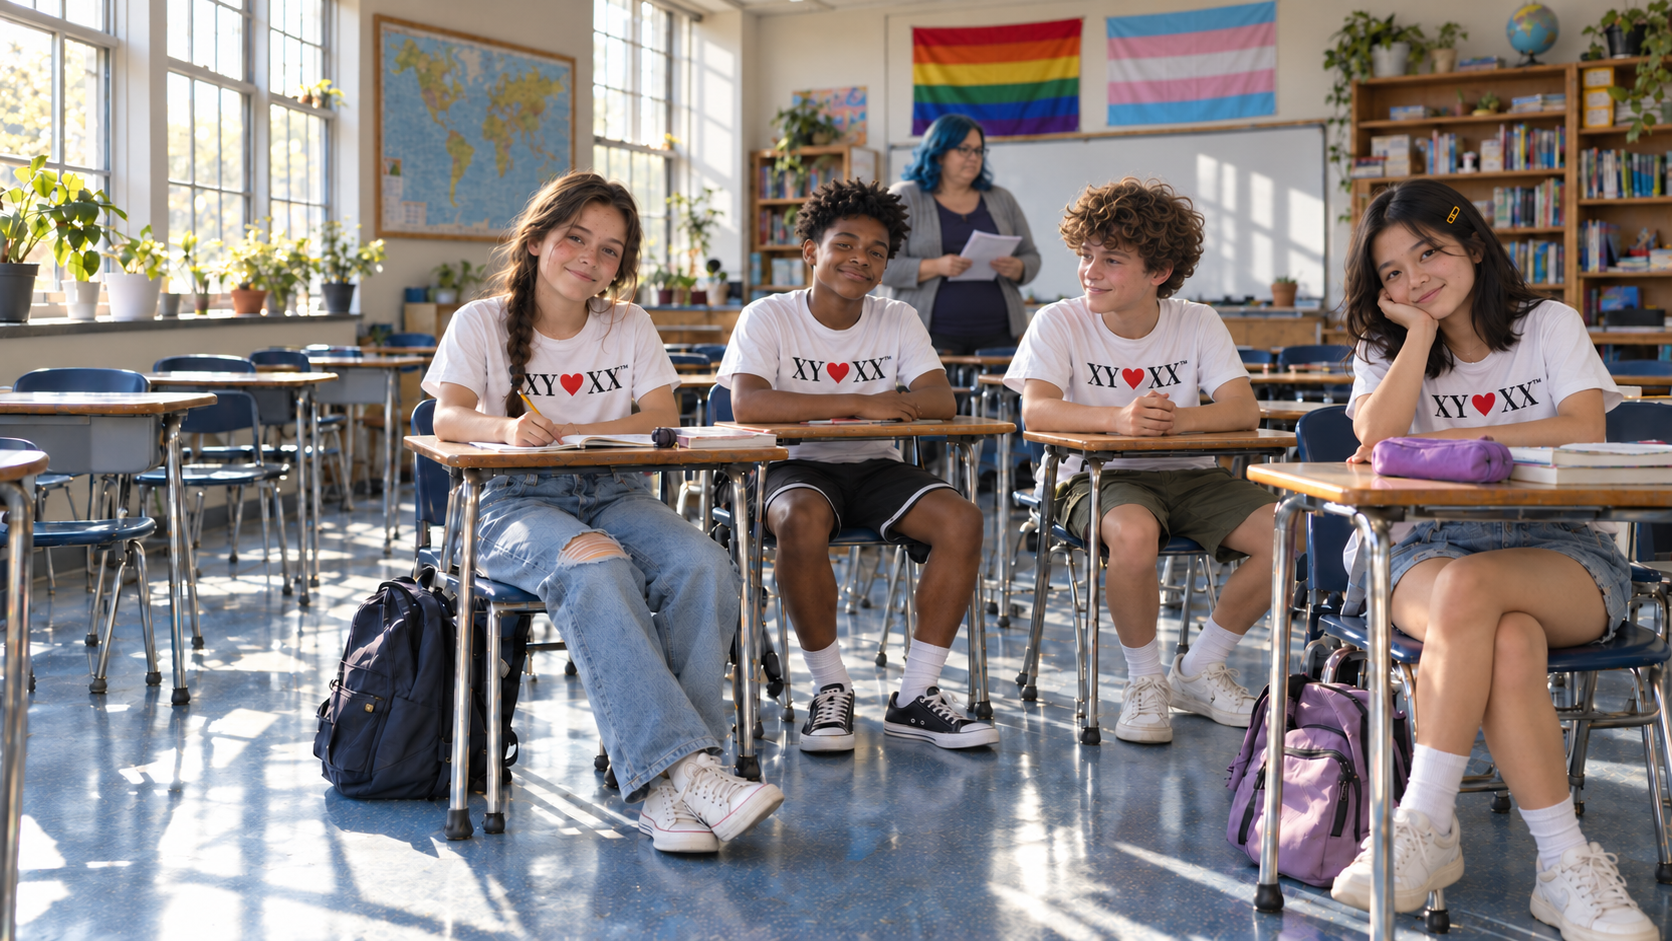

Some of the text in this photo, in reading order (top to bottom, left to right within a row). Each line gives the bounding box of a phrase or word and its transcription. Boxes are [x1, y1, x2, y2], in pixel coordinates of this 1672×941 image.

[792, 356, 825, 382] XY
[1087, 362, 1120, 388] XY
[524, 373, 558, 397] XY
[1431, 394, 1469, 419] XY
